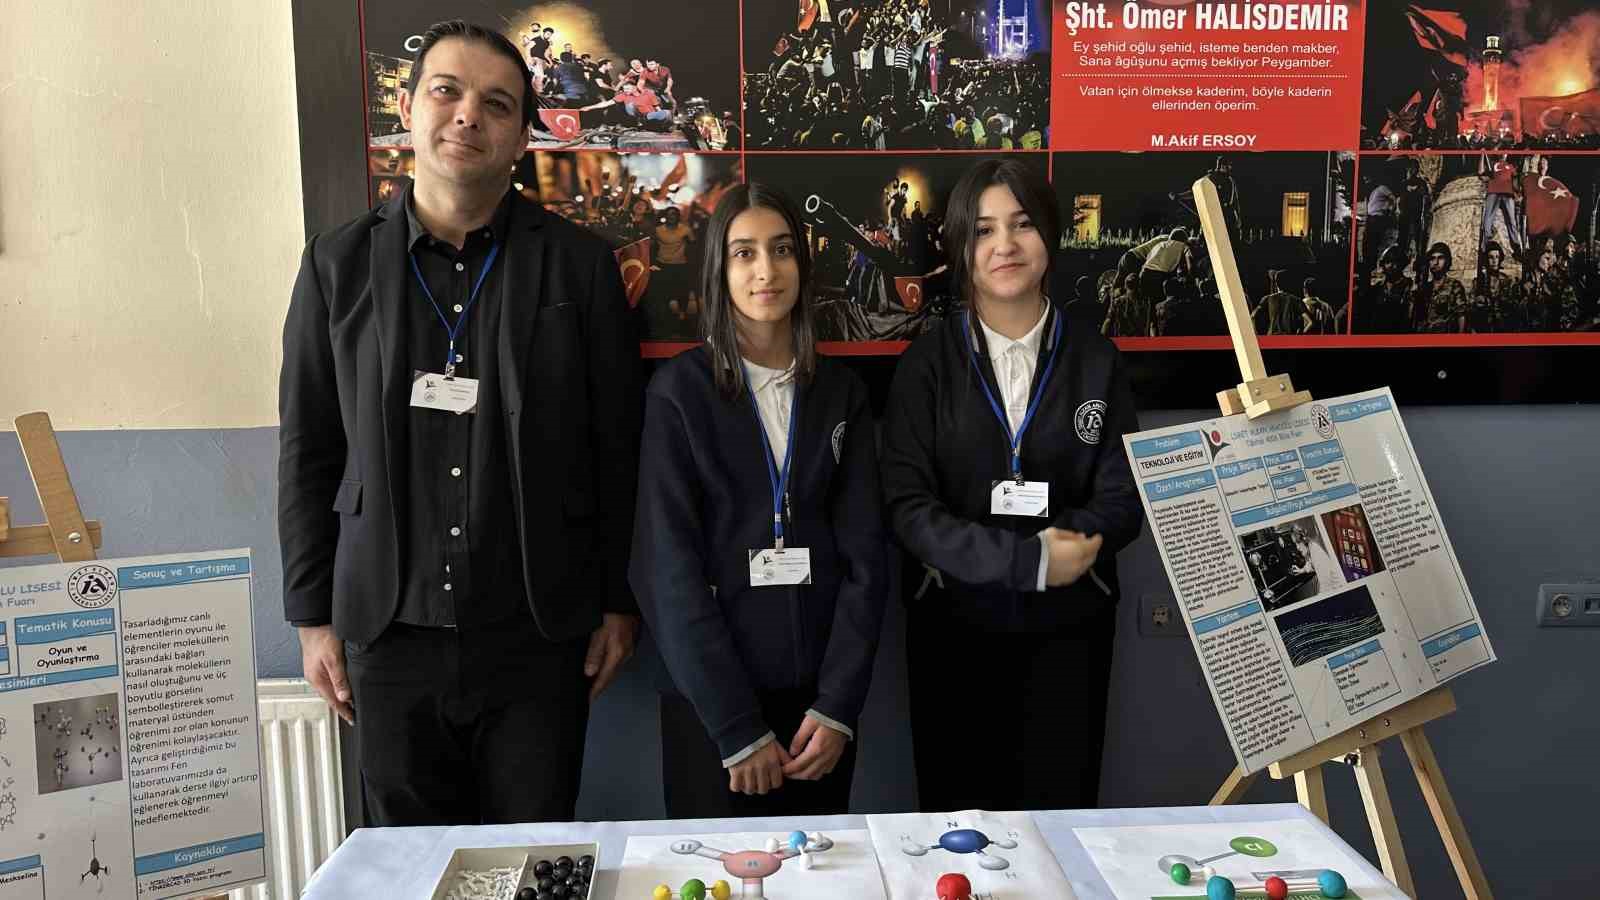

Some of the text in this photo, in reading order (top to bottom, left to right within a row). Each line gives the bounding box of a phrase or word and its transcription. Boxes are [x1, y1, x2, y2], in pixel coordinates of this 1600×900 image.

[1065, 0, 1348, 35] Şht. Ömer HALİSDEMİR
[1073, 41, 1341, 55] Ey şehid oğlu şehid, isteme benden makber,
[1079, 56, 1112, 66] Sana
[1171, 57, 1208, 69] açmış
[1211, 57, 1258, 69] bekliyor
[1262, 57, 1334, 70] Peygamber.
[1079, 86, 1332, 99] Vatan için ölmekse kaderim, böyle kaderin
[1152, 100, 1260, 112] ellerinden öperim.
[1151, 134, 1257, 147] M.Akif ERSOY
[133, 563, 237, 580] Sonuç ve Tartışma
[18, 616, 112, 633] Tematik Konusu
[124, 611, 211, 629] Tasarladığımız canlı
[124, 623, 226, 641] elementlerin oyunu ile
[48, 646, 73, 656] Oyun
[124, 635, 229, 655] öğrenciler moleküllerin
[37, 654, 100, 668] Oyunlaştırma
[125, 649, 205, 666] arasındaki bağları
[126, 658, 231, 678] kullanarak moleküllerin
[127, 671, 227, 691] nasıl oluştuğunu ve üç
[127, 686, 203, 704] boyutlu görselini
[128, 693, 234, 715] sembolleştirerek somut
[128, 708, 215, 728] materyal üstünden
[129, 715, 249, 741] öğrenimi zor olan konunun
[130, 740, 171, 753] öğrenimi
[131, 741, 237, 765] Ayrıca geliştirdiğimiz bu
[171, 761, 188, 770] Fen
[132, 766, 227, 789] laboratuvarımızda da
[133, 786, 180, 801] kullanarak
[182, 782, 207, 793] derse
[133, 790, 229, 815] eğlenerek öğrenmeyi
[174, 845, 227, 864] Kaynaklar
